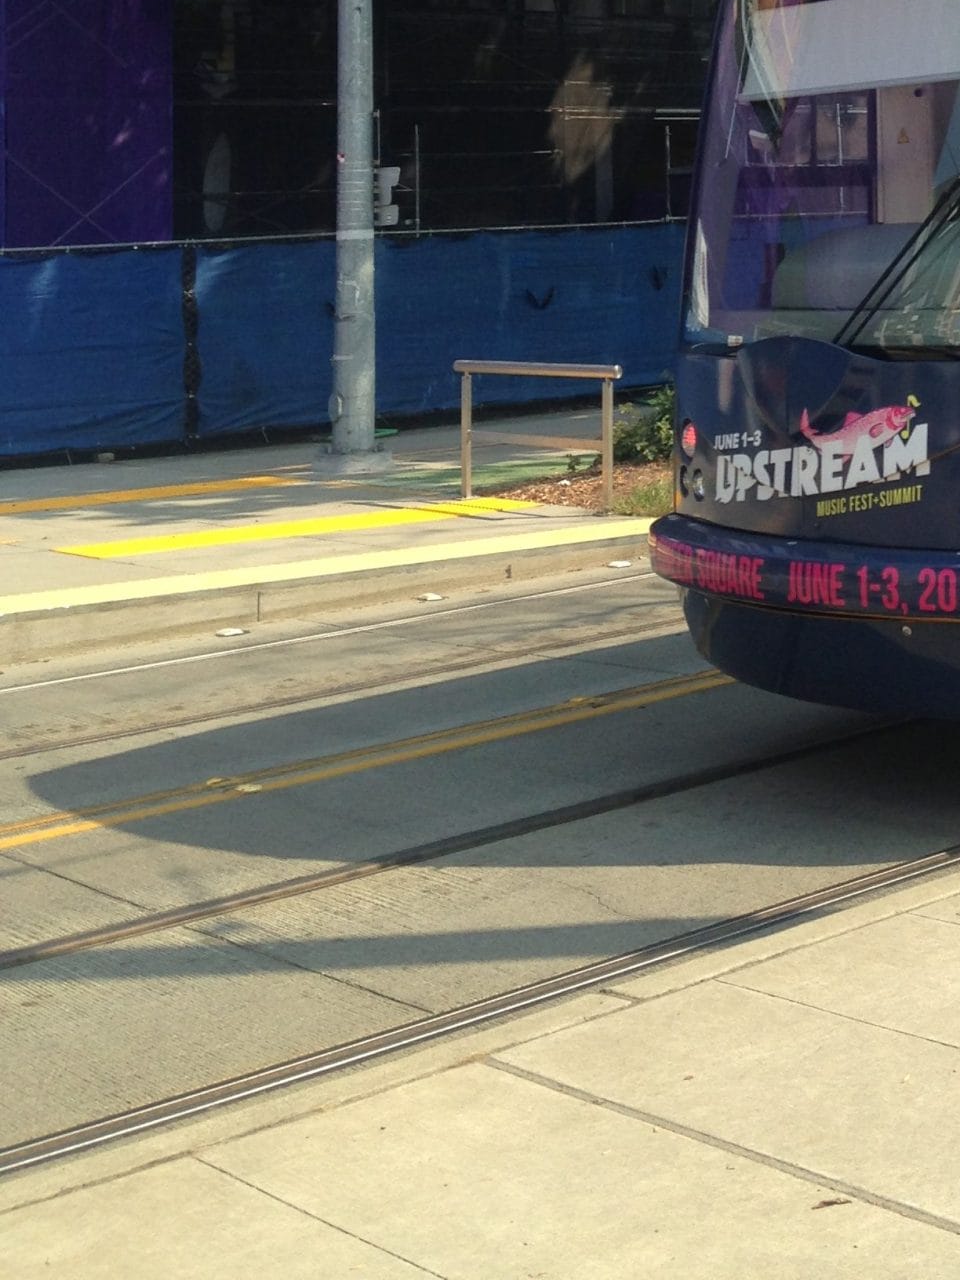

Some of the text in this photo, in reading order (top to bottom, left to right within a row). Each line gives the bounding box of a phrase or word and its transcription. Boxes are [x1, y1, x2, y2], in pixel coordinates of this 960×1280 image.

[713, 430, 762, 450] JUNE 1-3
[715, 423, 931, 504] UPSTREAM
[816, 485, 923, 517] MUSIC FEST+SUMMIT
[696, 549, 765, 599] SQUARE
[787, 561, 845, 607] JUNE
[857, 565, 909, 615] 1-3,
